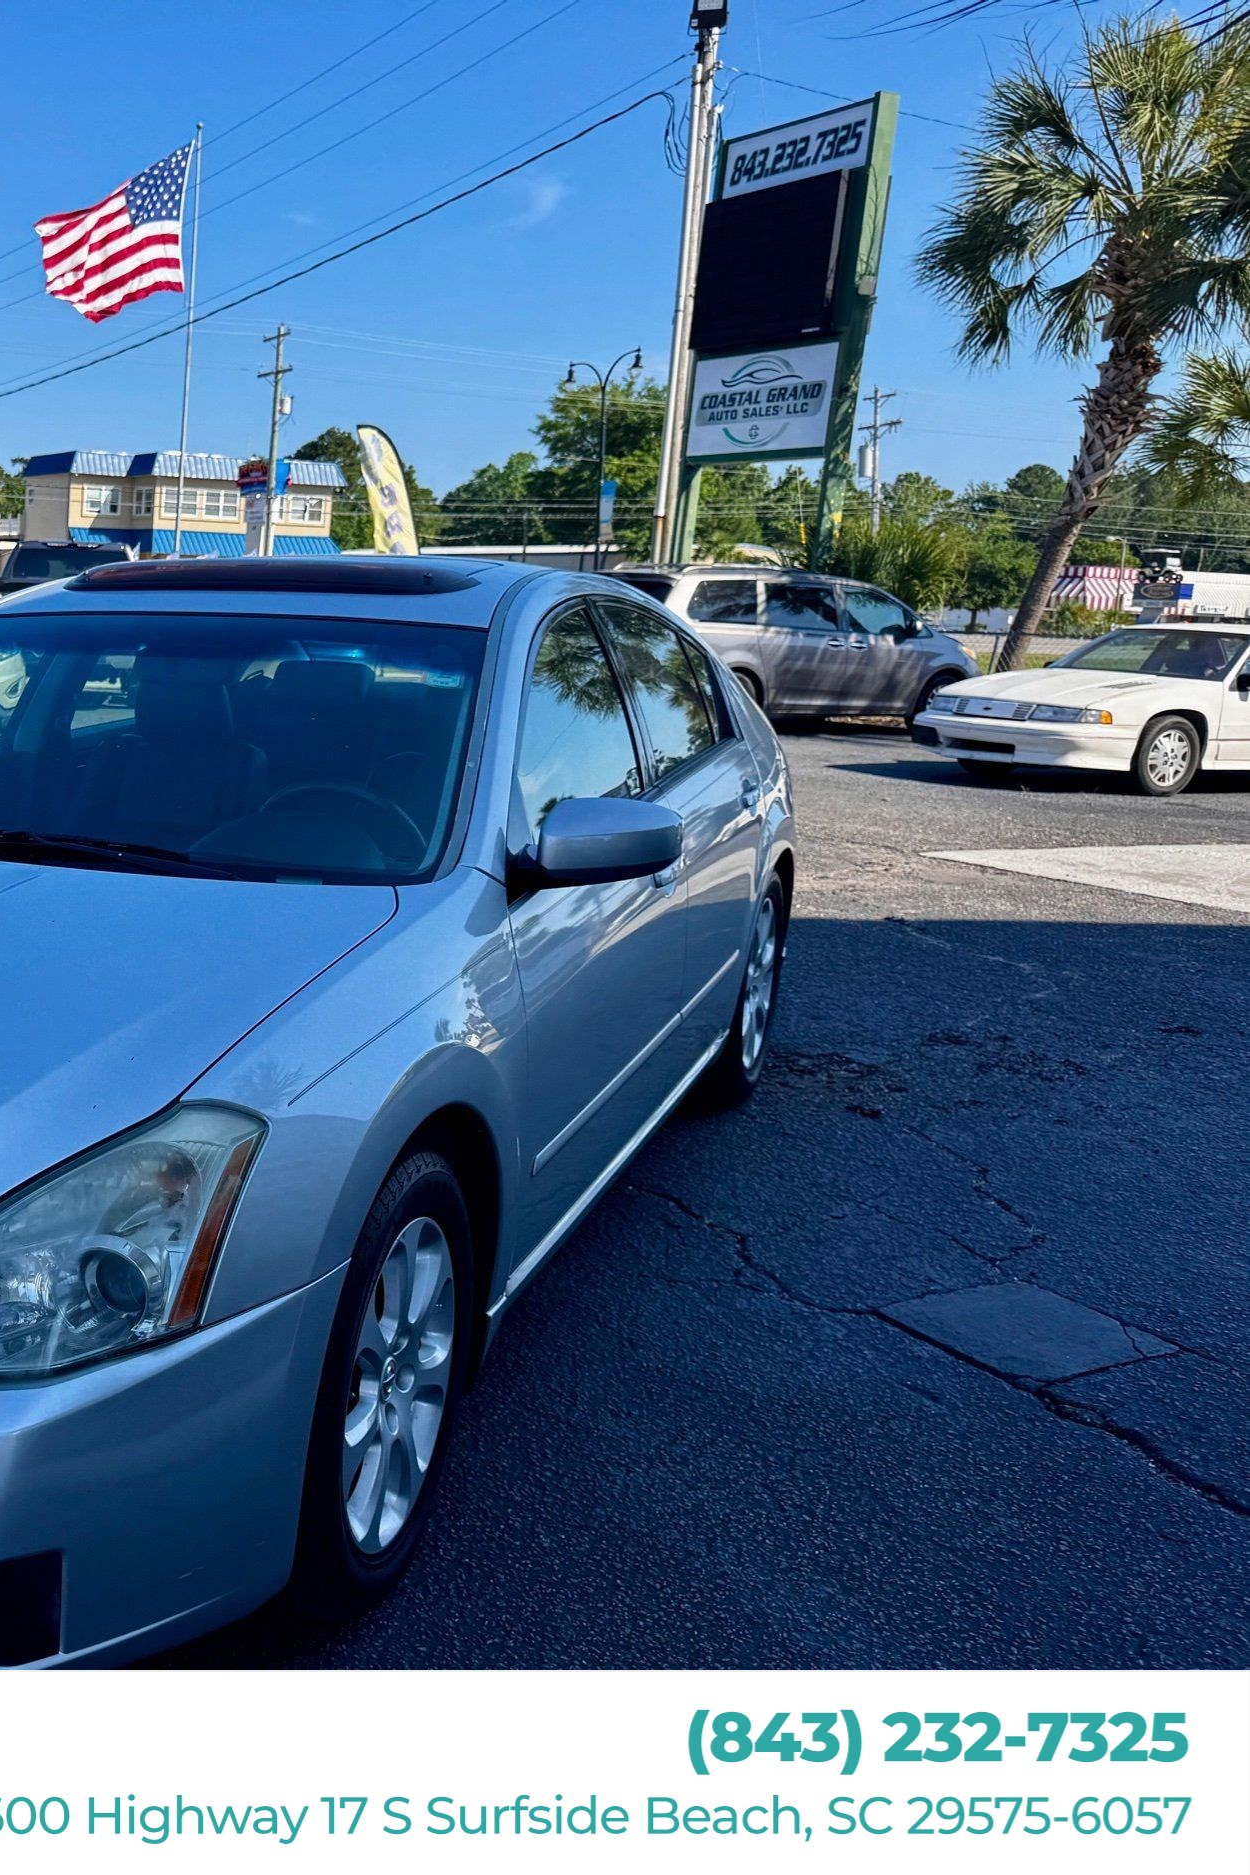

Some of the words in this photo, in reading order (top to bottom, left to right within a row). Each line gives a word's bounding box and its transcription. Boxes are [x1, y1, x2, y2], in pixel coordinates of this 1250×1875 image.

[729, 118, 867, 187] 843.232.7325
[700, 390, 761, 410] COASTAL
[766, 383, 823, 402] GRAND
[708, 409, 738, 422] AUTO
[786, 402, 809, 415] LLC
